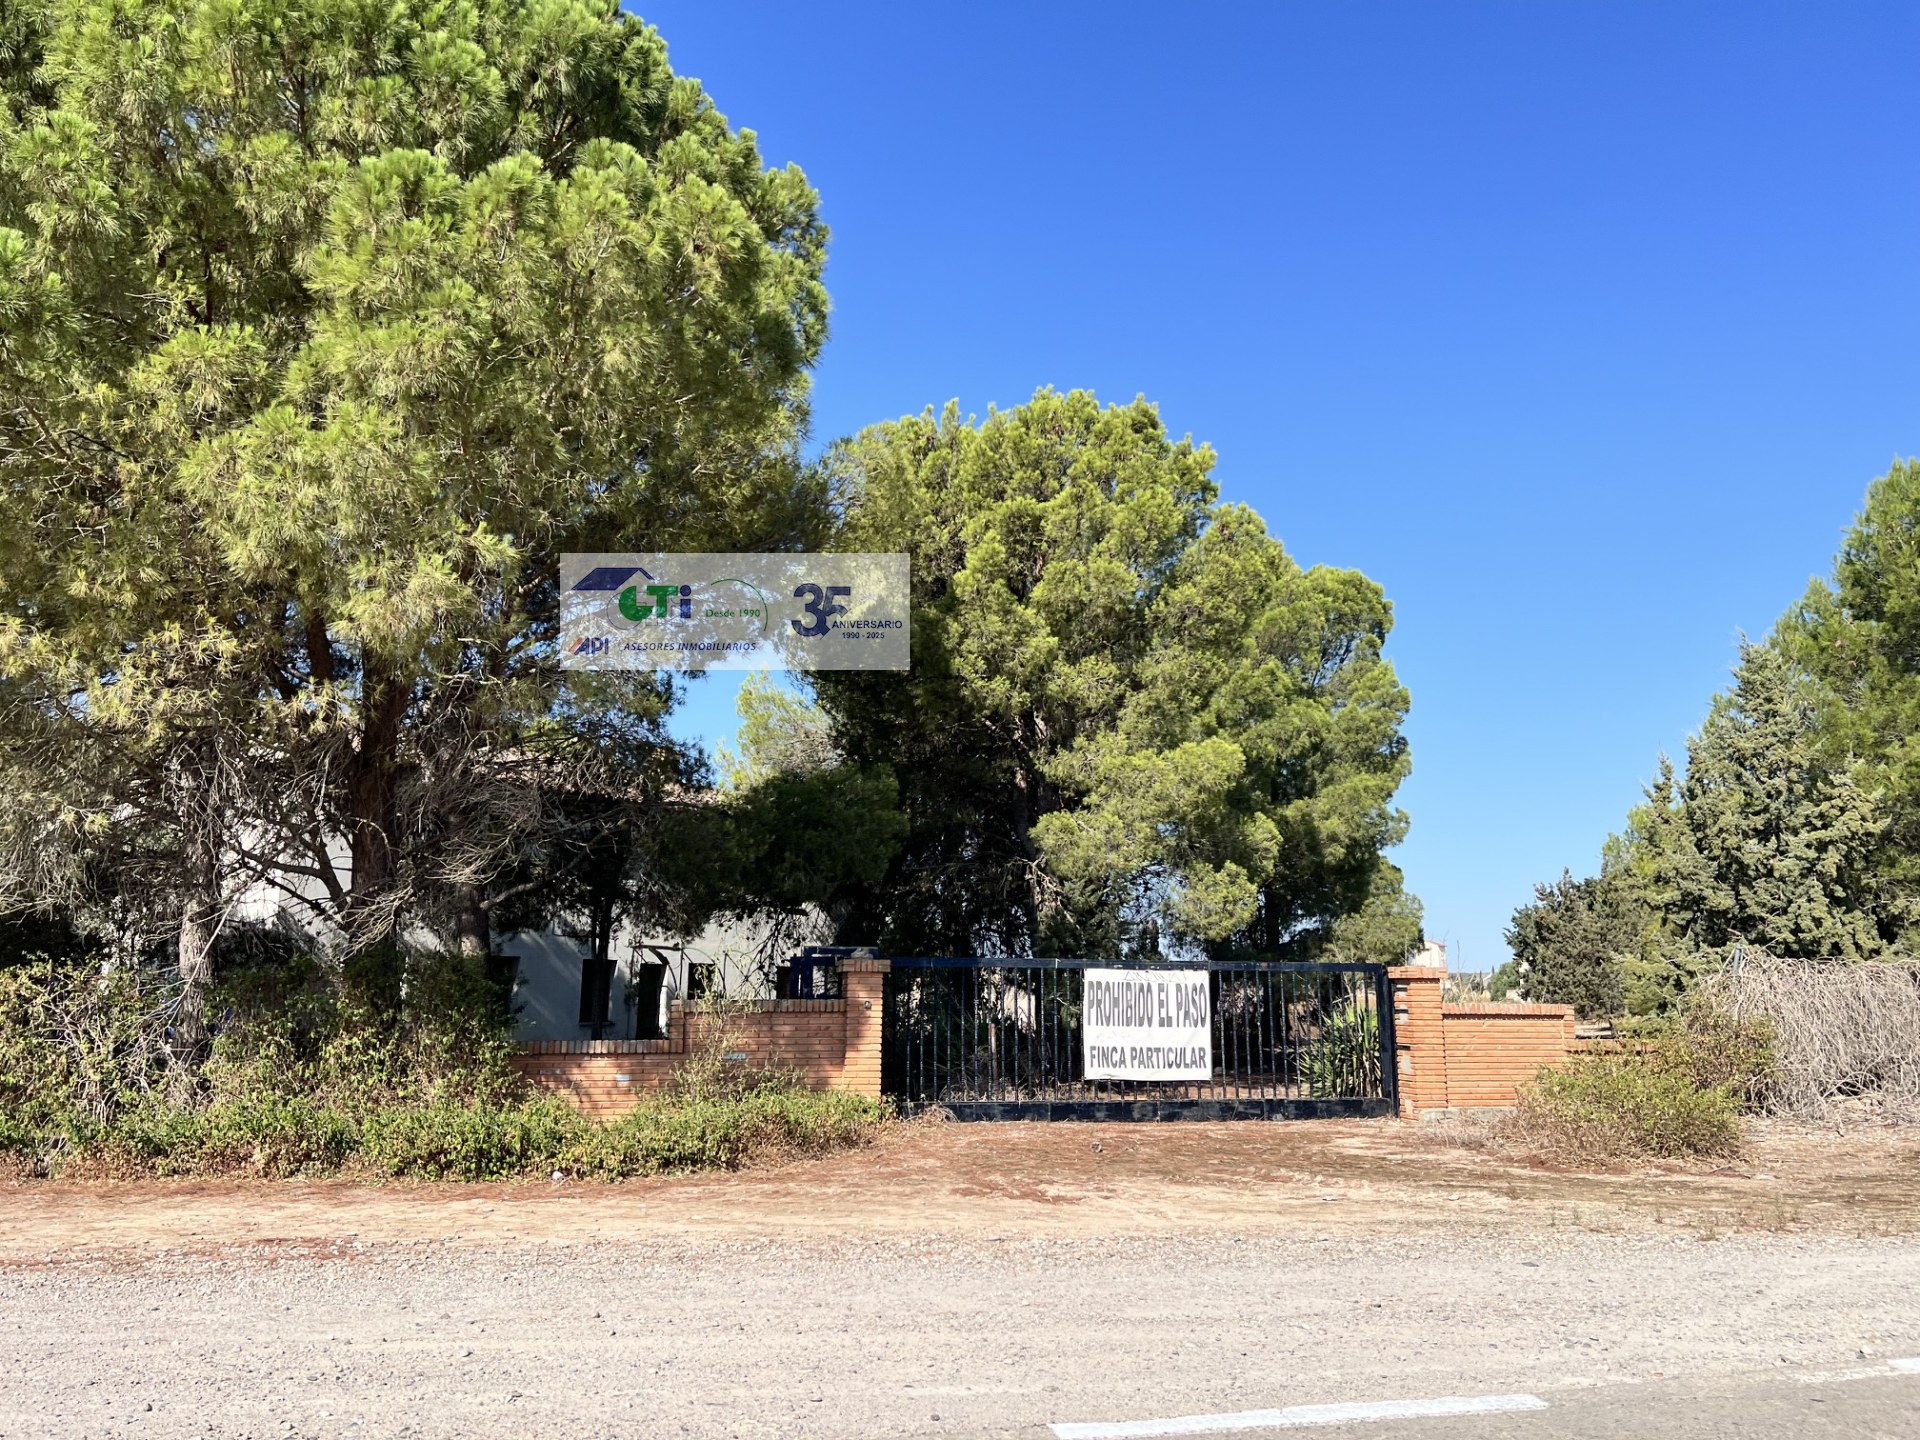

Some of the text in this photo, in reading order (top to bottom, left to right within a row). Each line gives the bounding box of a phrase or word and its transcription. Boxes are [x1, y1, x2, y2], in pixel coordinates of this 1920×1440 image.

[1087, 980, 1208, 1029] PROHIBIDO EL PASO
[1090, 1045, 1207, 1070] FINCA PARTICULAR
